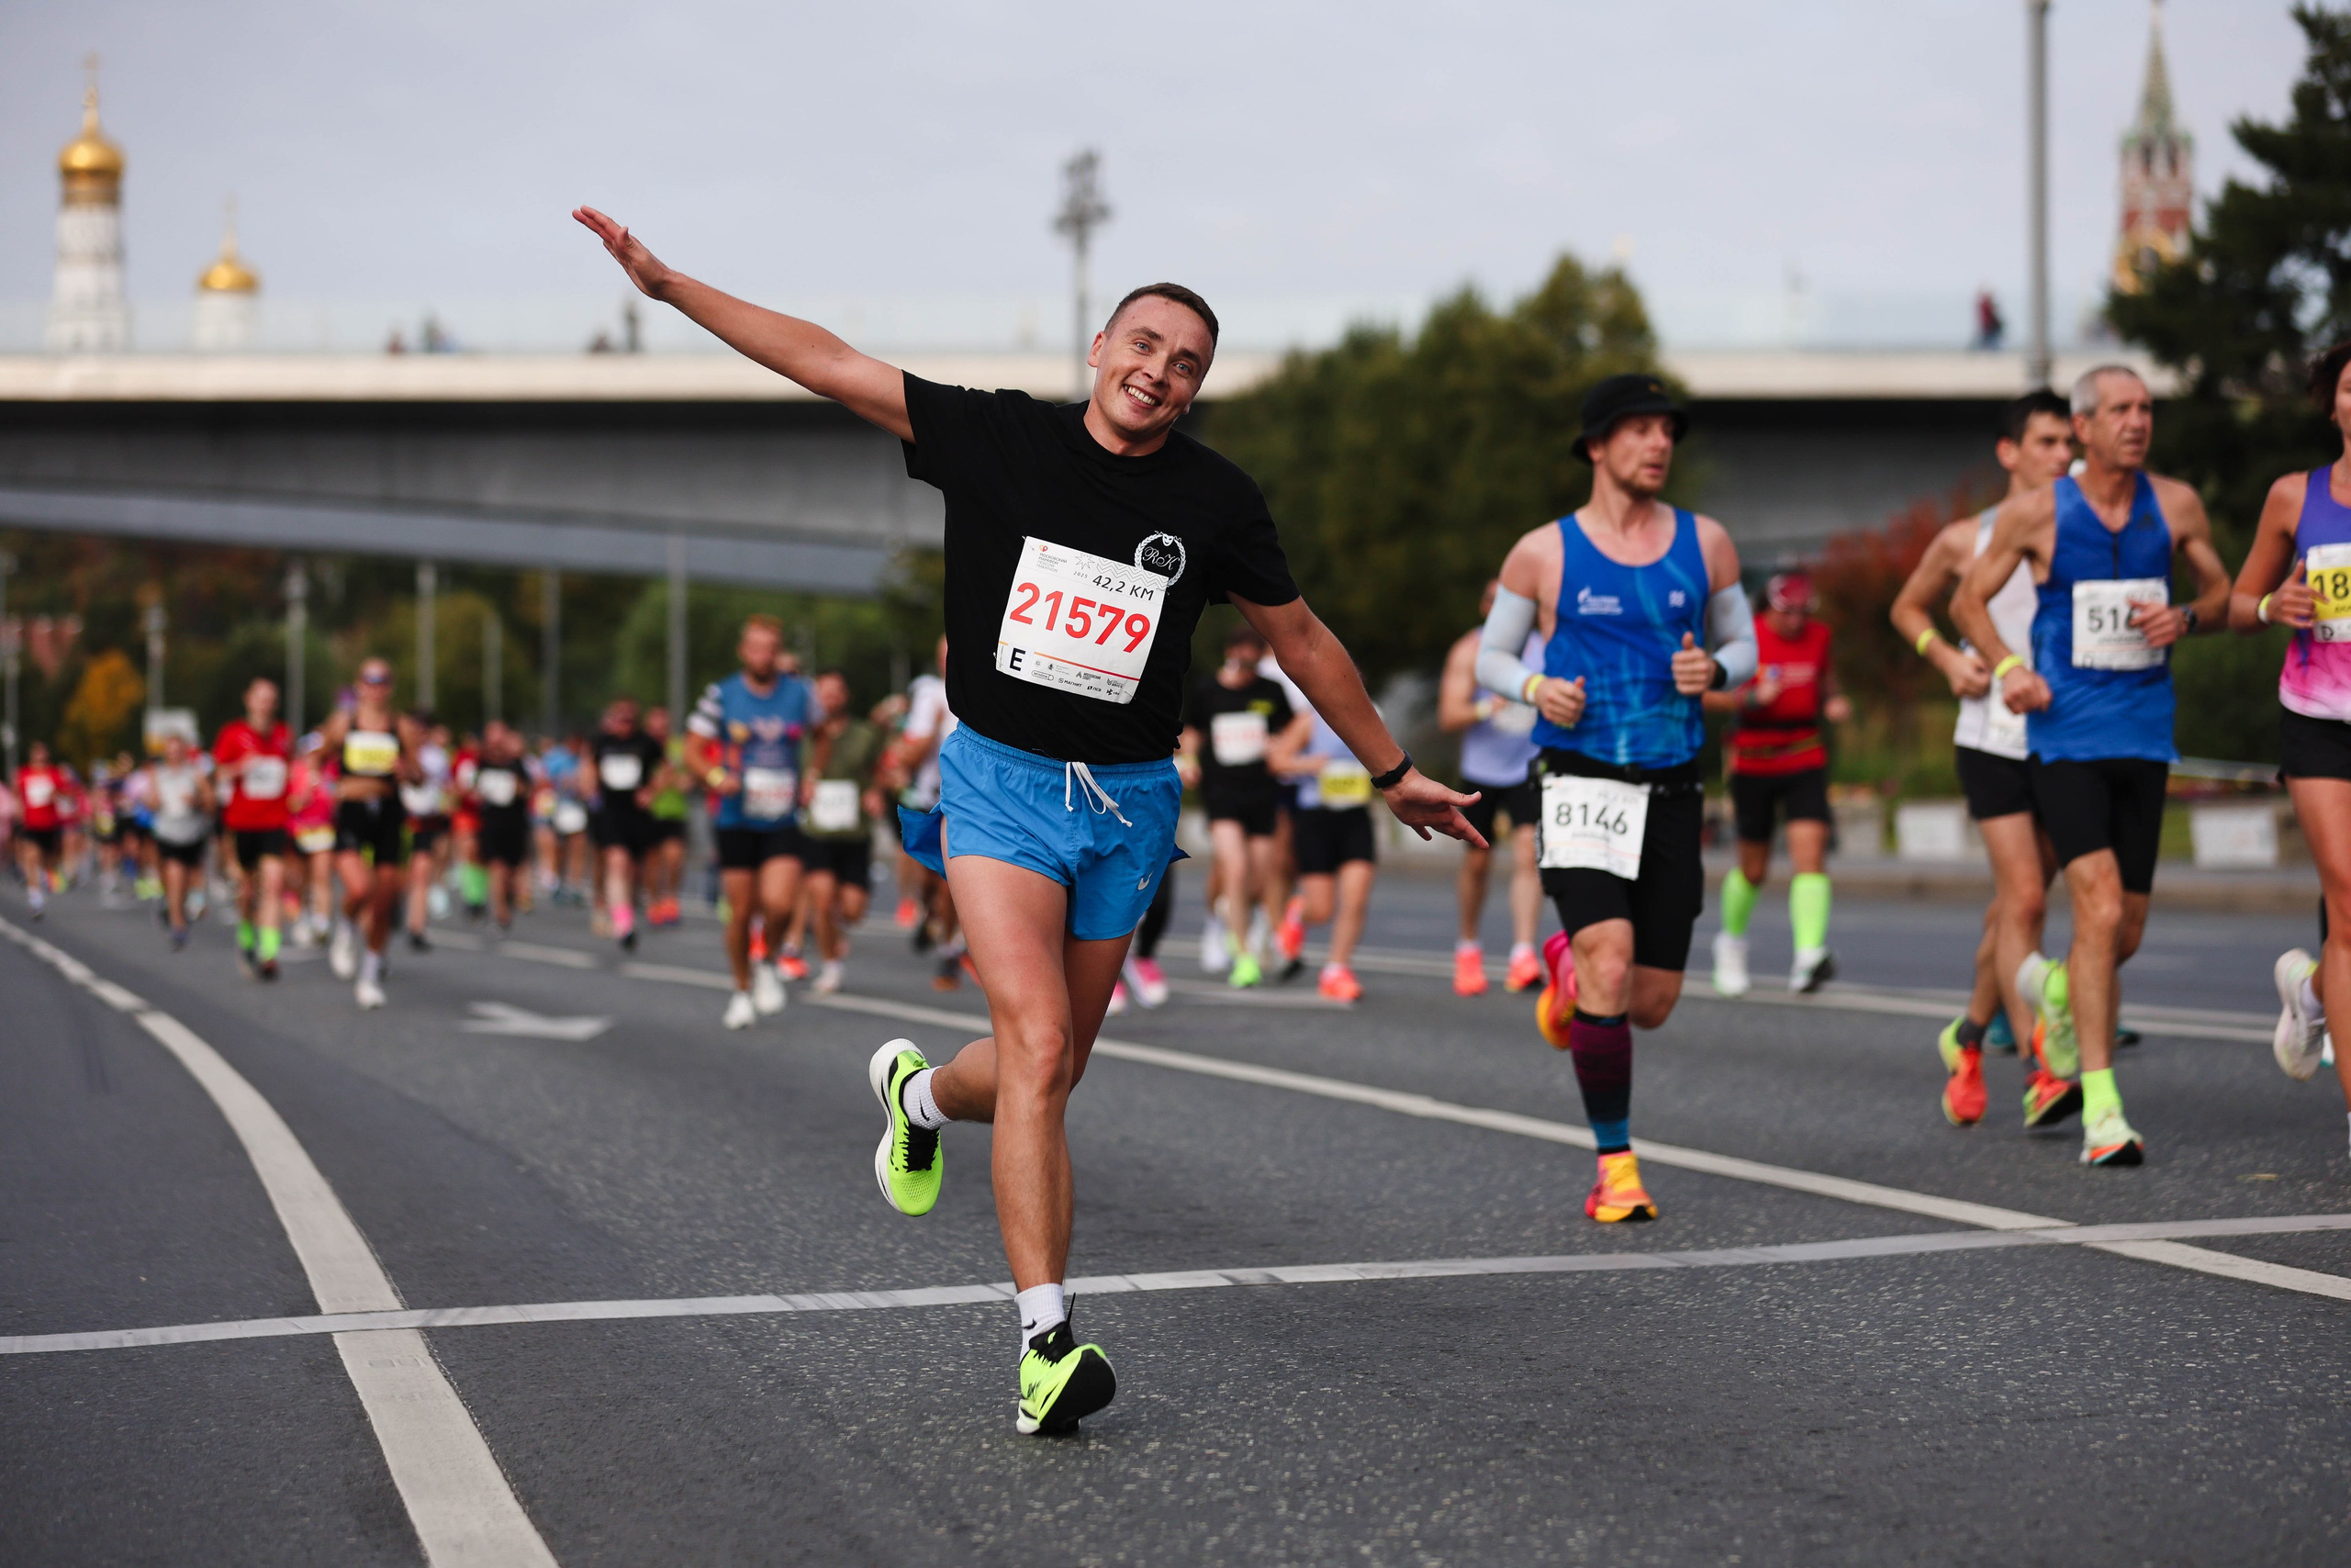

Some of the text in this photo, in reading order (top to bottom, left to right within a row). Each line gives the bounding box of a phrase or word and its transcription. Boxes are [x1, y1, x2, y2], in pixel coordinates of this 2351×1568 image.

[1073, 570, 1089, 579] 2025
[1092, 575, 1154, 601] 42,2 KM
[1010, 582, 1151, 654] 21579
[1010, 647, 1026, 672] E
[1555, 801, 1629, 835] 8146
